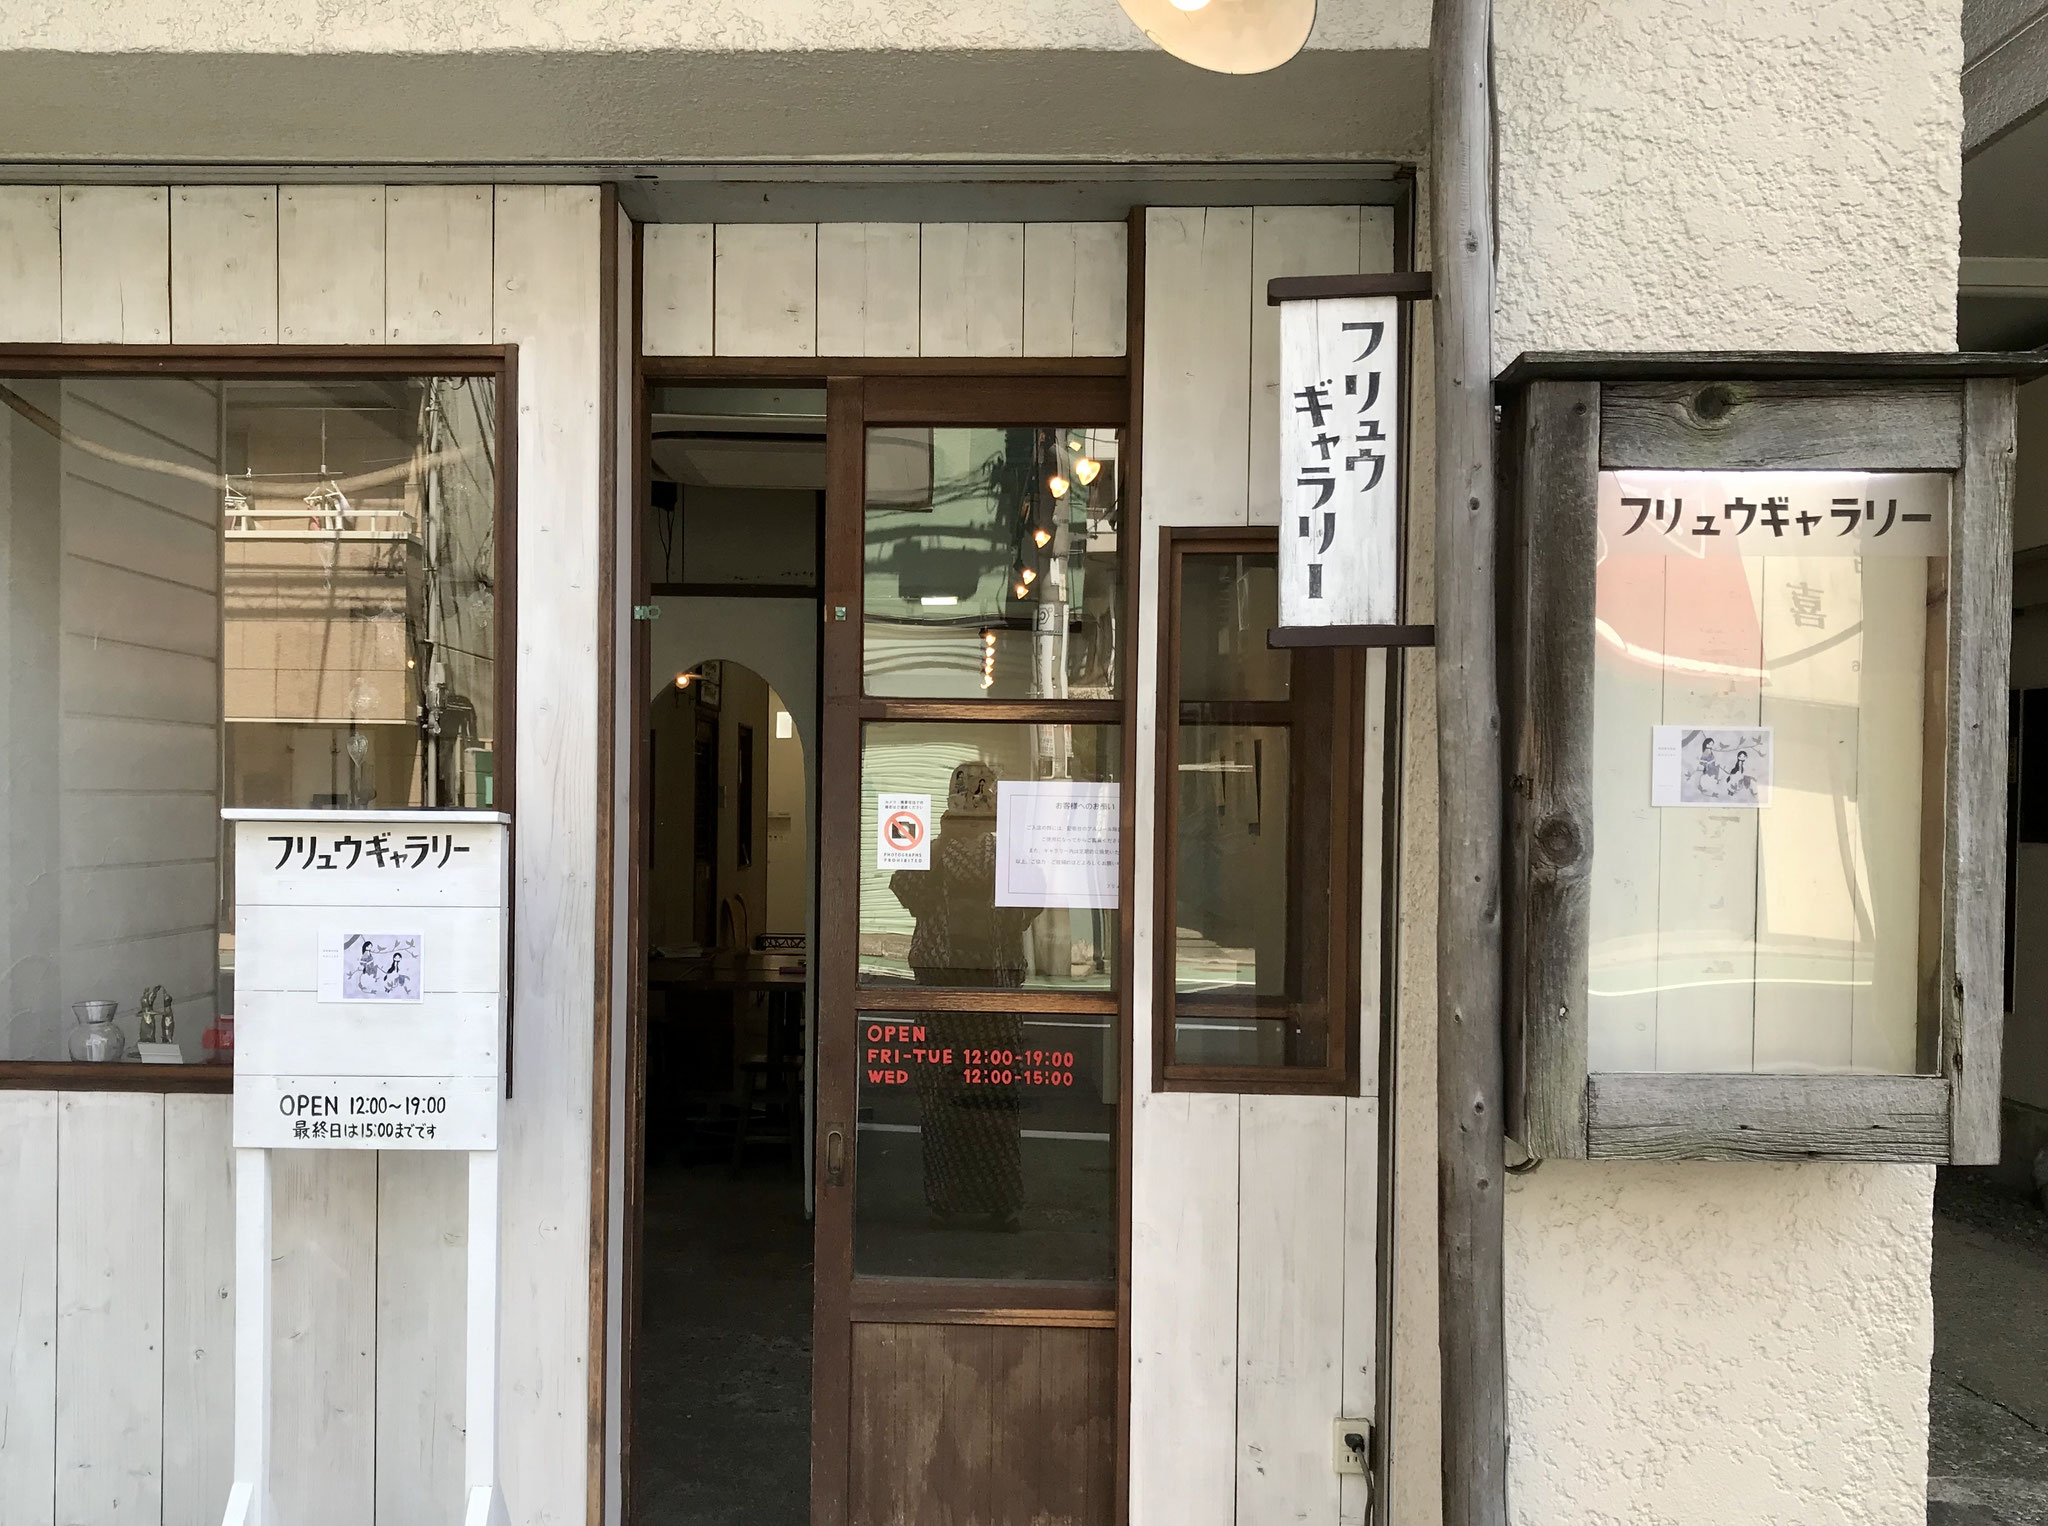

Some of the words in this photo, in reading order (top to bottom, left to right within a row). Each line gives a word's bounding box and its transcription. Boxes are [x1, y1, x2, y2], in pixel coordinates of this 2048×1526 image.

[1341, 321, 1386, 493] フリュウ
[1293, 378, 1341, 599] ギャラリー
[1620, 495, 1932, 538] フリュウギャラリー
[267, 832, 470, 870] フリュウギャラリー
[867, 1024, 926, 1043] OPEN
[867, 1048, 953, 1065] FRI-TUE
[963, 1049, 1074, 1068] 12:00-19:00
[868, 1069, 909, 1085] WED
[963, 1068, 1074, 1087] 12:00-15:00
[279, 1094, 339, 1116] OPEN
[292, 1120, 437, 1139] 最終日は15:00までです
